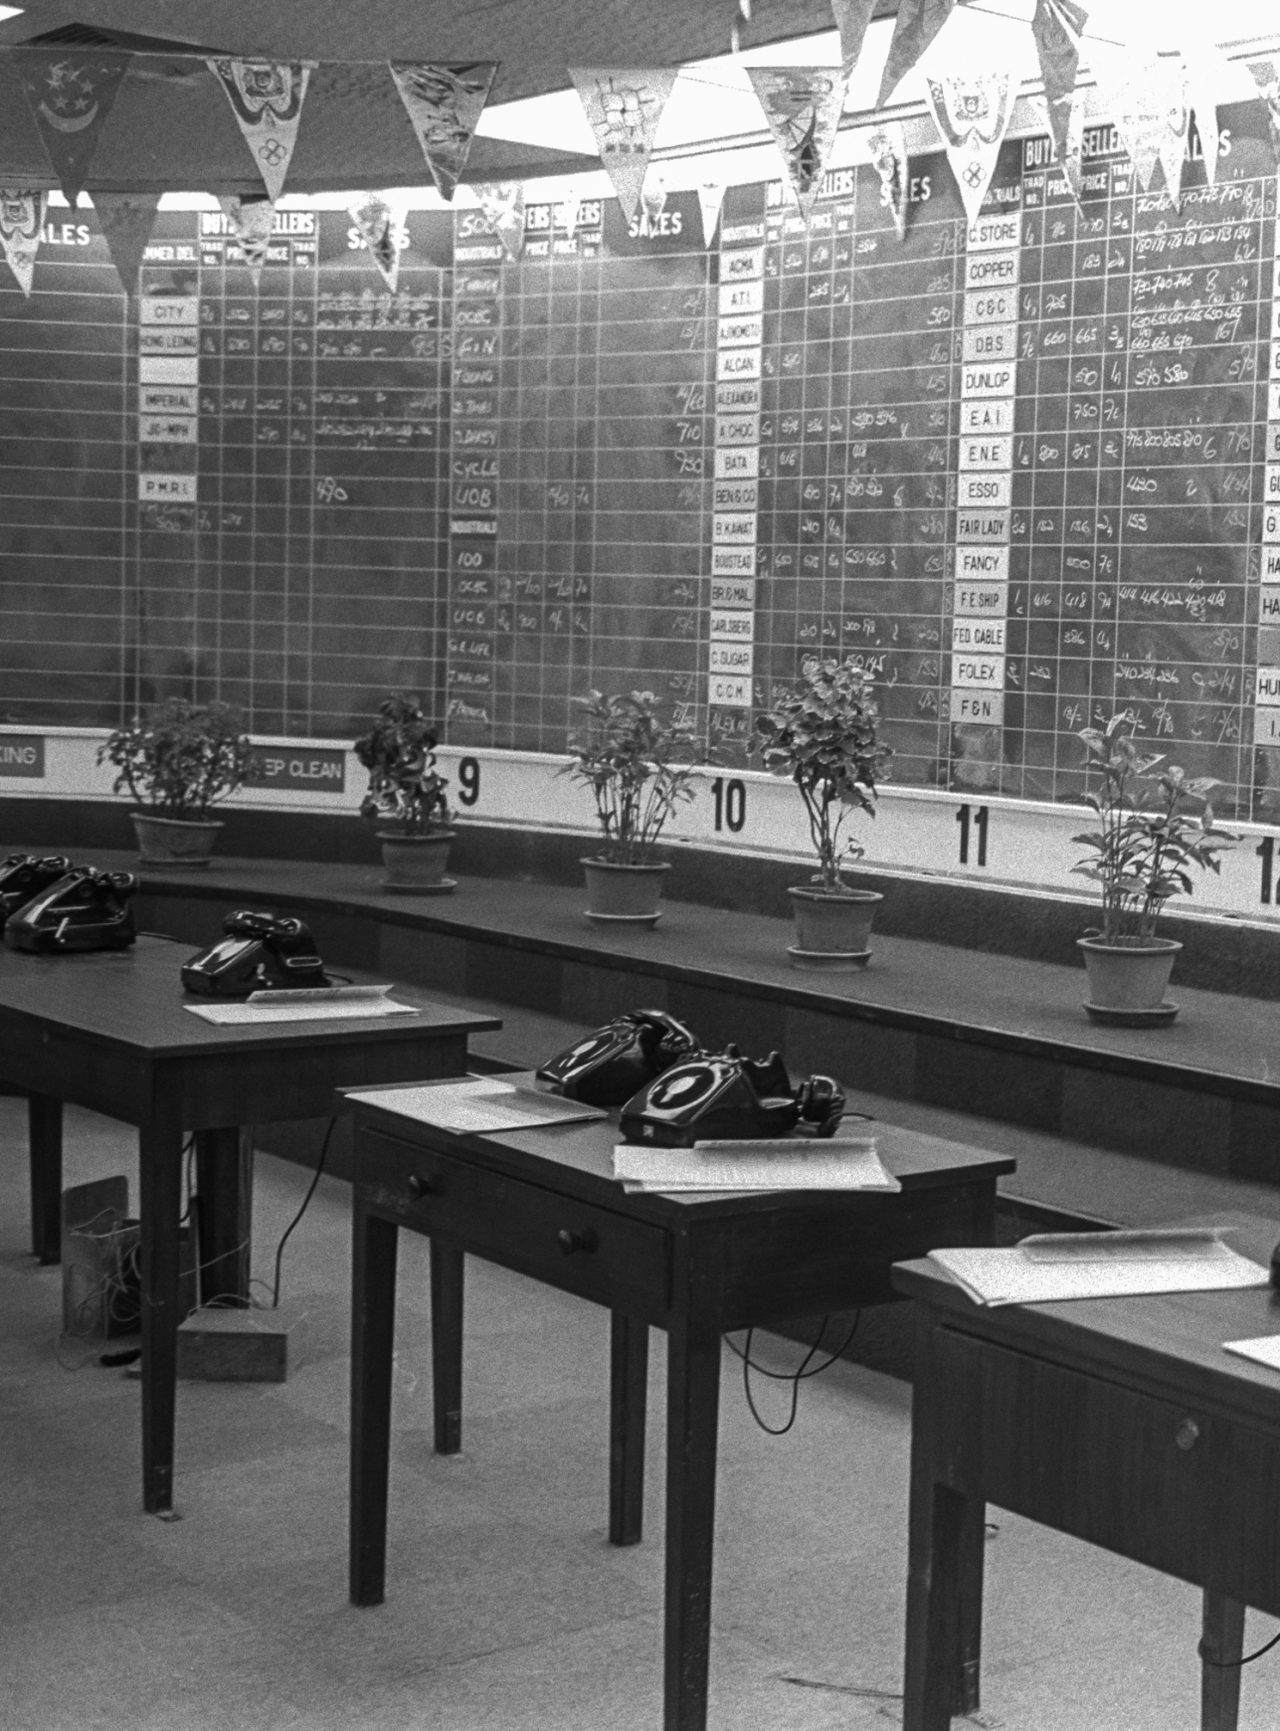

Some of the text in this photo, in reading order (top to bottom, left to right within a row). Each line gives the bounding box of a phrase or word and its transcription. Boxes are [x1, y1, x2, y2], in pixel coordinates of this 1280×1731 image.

[38, 223, 90, 246] ALES
[970, 260, 1014, 280] COPPER
[153, 305, 184, 319] CITY
[724, 357, 754, 373] ALCAN
[966, 371, 1010, 389] DUNLOP
[724, 456, 747, 471] BATA
[968, 482, 999, 498] ESSO
[959, 519, 1004, 536] FAIR LADY
[963, 555, 1000, 571] FANCY
[953, 627, 1003, 645] FED CABLE
[958, 664, 996, 680] FOLEX
[263, 758, 342, 779] EP CLEAN
[457, 756, 481, 806] 9
[711, 777, 747, 833] 10
[955, 803, 990, 866] 11
